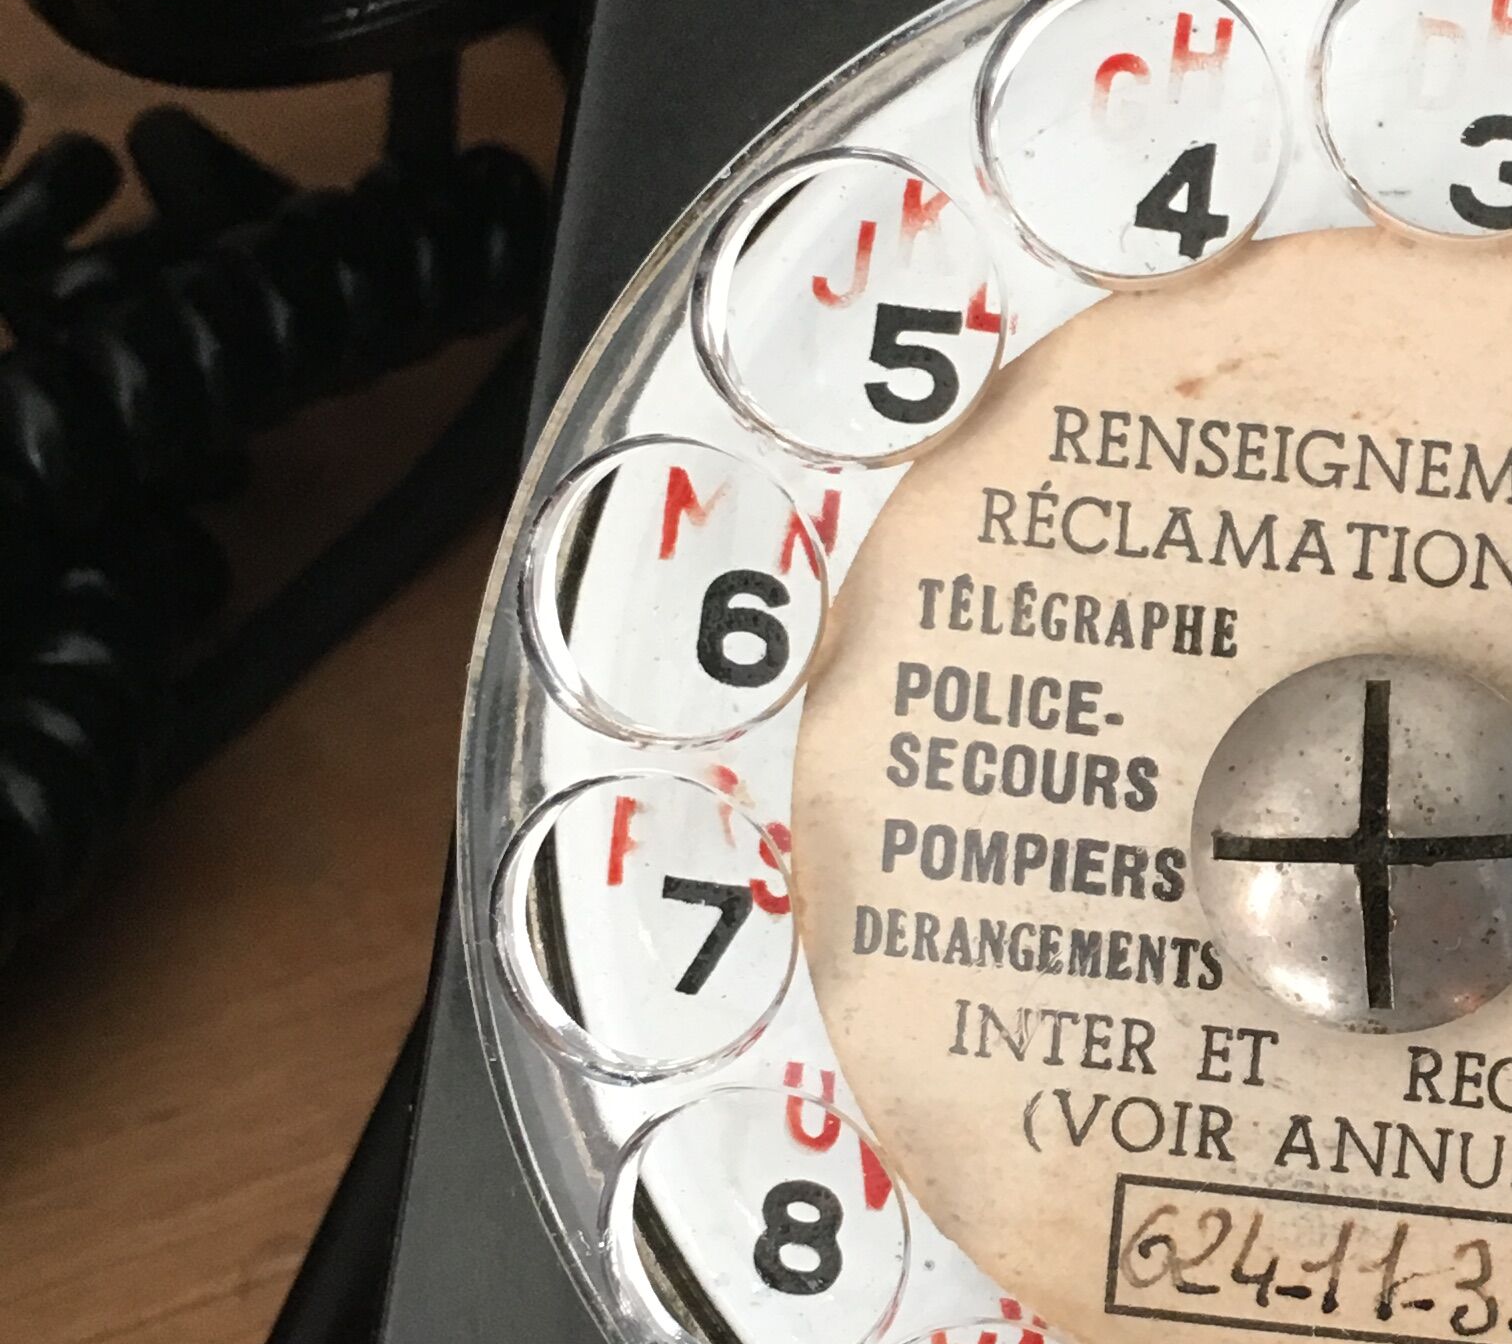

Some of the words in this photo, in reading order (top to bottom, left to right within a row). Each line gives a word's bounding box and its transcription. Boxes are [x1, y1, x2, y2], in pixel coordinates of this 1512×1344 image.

[1134, 142, 1230, 260] 4
[864, 302, 963, 425] 5
[696, 568, 790, 689] 6
[917, 572, 1241, 659] TÉLÉGRAPHE
[893, 661, 1127, 738] POLICE-
[885, 732, 1160, 815] SECOURS
[880, 818, 1188, 904] POMPIERS
[661, 874, 754, 995] 7
[852, 904, 1225, 992] DERANGEMENTS
[948, 998, 1159, 1075] INTER
[1196, 1024, 1280, 1087] ET
[1022, 1088, 1238, 1162] (VOIR
[753, 1179, 844, 1296] 8
